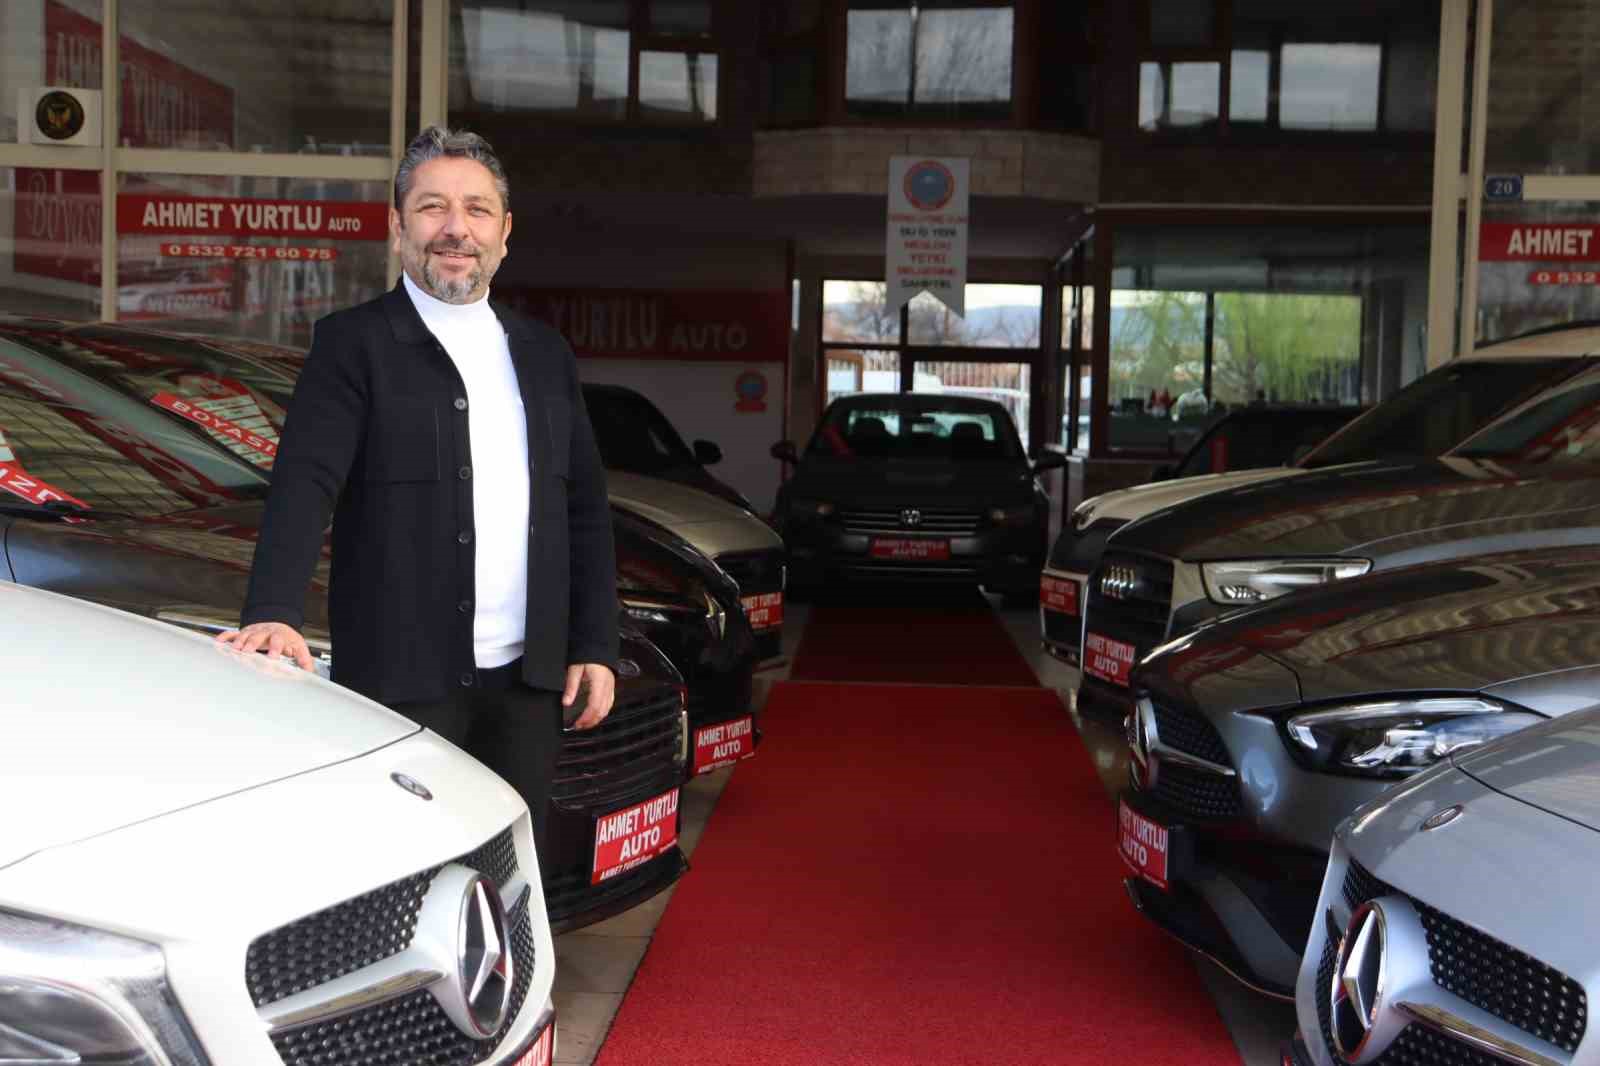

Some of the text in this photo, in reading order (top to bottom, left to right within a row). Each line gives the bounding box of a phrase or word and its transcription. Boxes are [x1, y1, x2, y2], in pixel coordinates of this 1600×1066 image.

[142, 201, 361, 232] AHMET YURTLU AUTO
[169, 245, 331, 260] 0 532 721 60 75
[1507, 229, 1593, 255] AHMET
[1536, 272, 1550, 283] 0
[671, 323, 748, 351] AUTO
[1093, 654, 1119, 676] AUTO
[698, 725, 725, 748] AHMET
[712, 739, 741, 760] AUTO
[598, 788, 679, 846] AHMET YURTLU
[620, 825, 661, 862] AUTO
